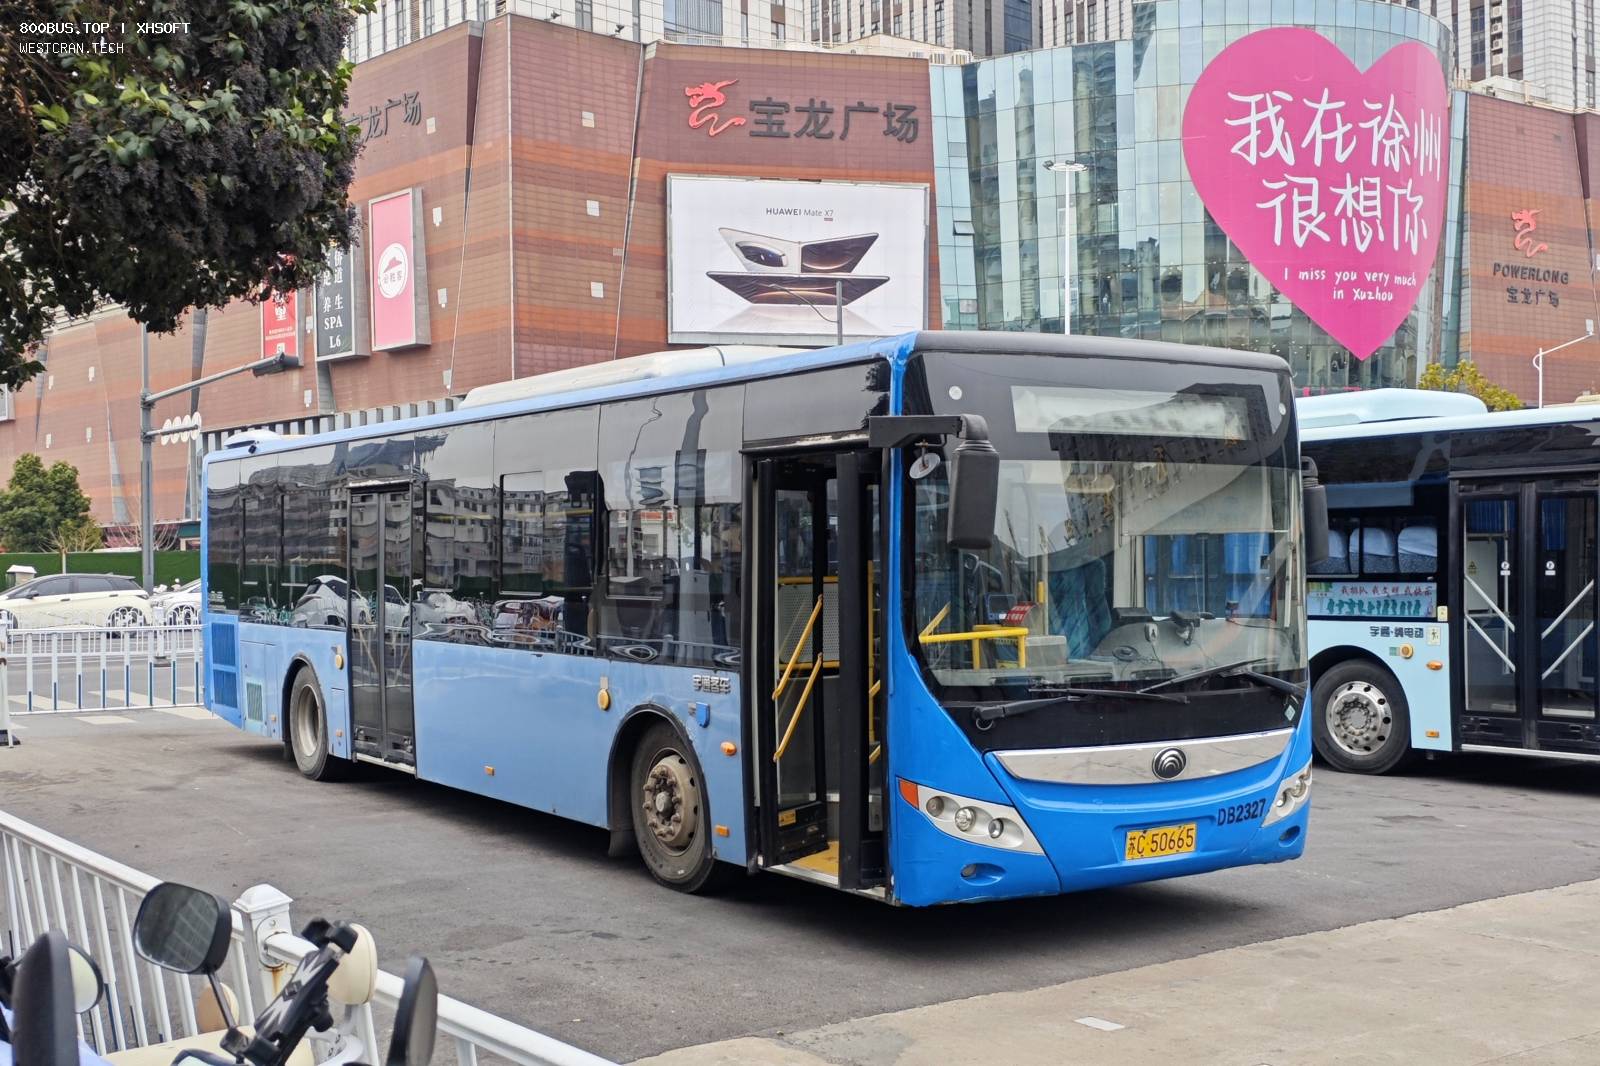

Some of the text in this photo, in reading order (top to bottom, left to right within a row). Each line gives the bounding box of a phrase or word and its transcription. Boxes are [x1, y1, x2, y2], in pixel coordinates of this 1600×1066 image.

[749, 97, 919, 144] 宝龙广场
[1224, 88, 1441, 182] 我在徐州
[765, 207, 834, 217] HUAWEI Mate X7
[1256, 172, 1428, 255] 很想你
[1284, 267, 1417, 287] I miss you very much
[1493, 262, 1569, 285] POWERLONG
[1333, 286, 1393, 302] in Xuzhou
[324, 314, 343, 330] SPA
[329, 334, 341, 349] L6
[1217, 799, 1266, 827] DB2327
